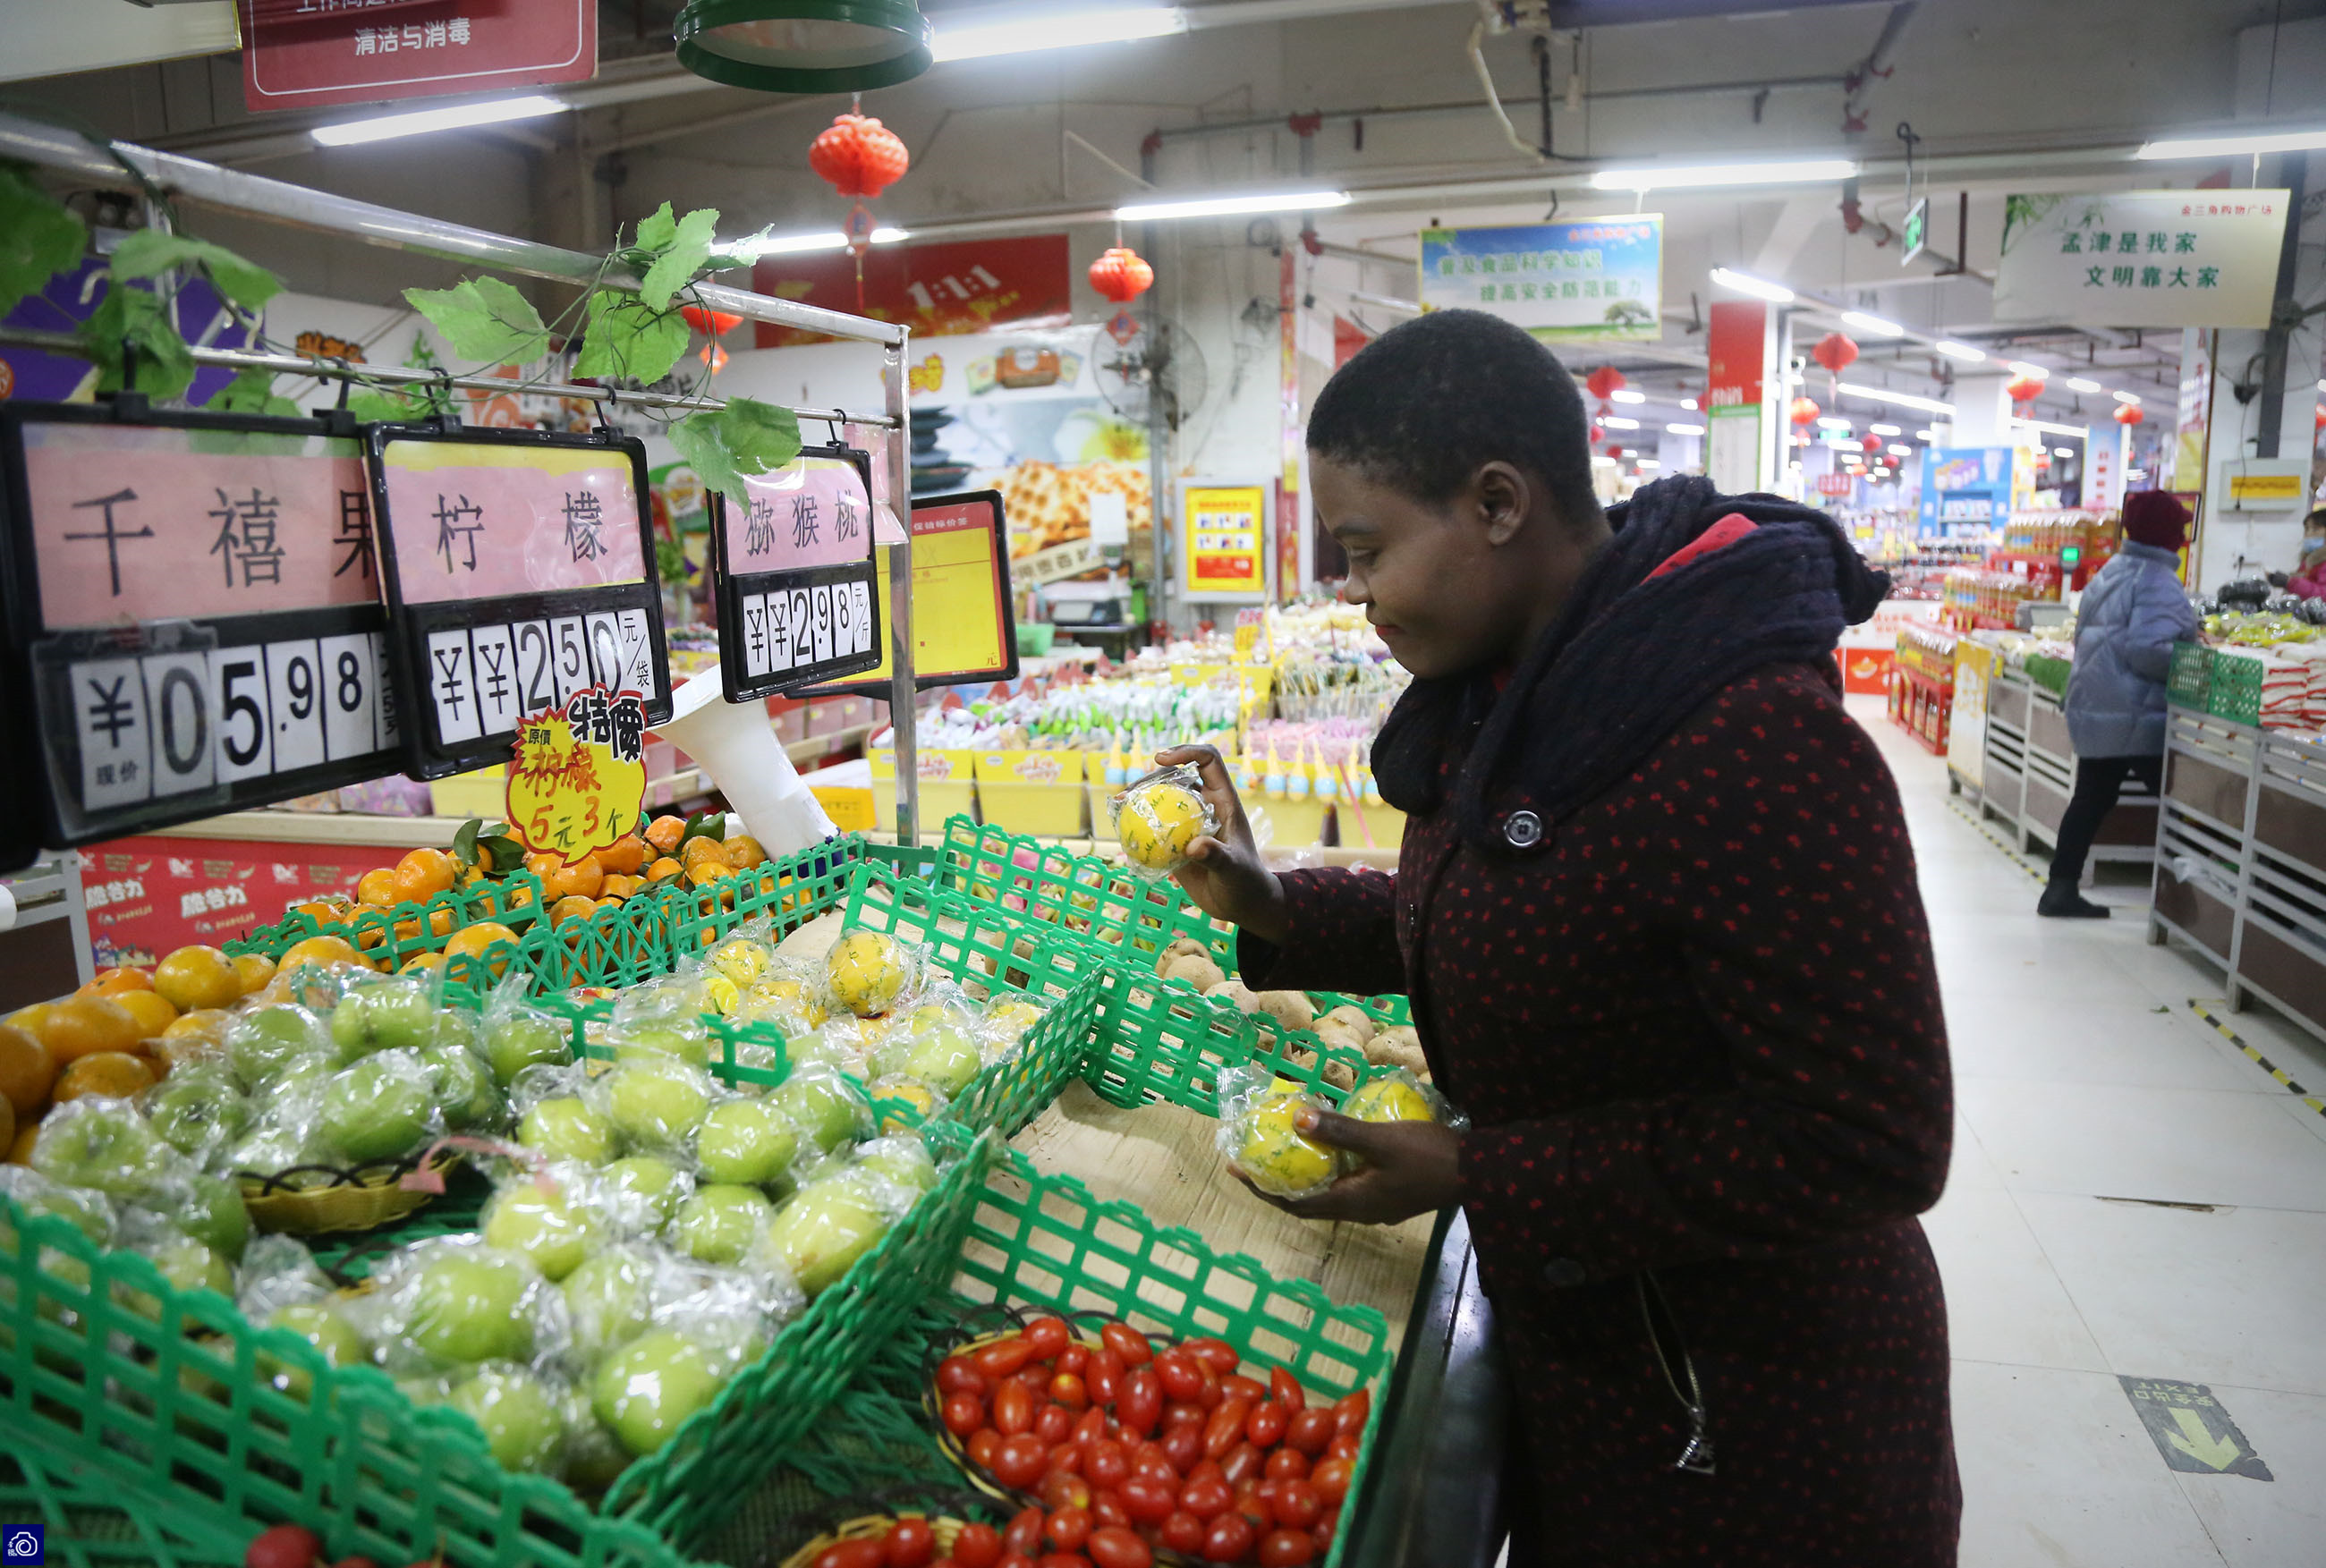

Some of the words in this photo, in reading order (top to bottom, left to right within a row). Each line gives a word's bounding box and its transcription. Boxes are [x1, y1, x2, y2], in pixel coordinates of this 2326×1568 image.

[354, 17, 471, 55] 清洁与消毒
[2181, 204, 2273, 217] 金三角购物广场
[2060, 231, 2198, 254] 孟津是我家
[907, 265, 1001, 308] 1:1:1
[2083, 266, 2220, 288] 文明靠大家
[431, 490, 607, 574] 柠檬
[743, 489, 859, 557] 猕猴桃
[63, 487, 376, 597] 千禧果
[528, 728, 551, 746] 原價
[95, 762, 139, 785] 现价
[530, 795, 624, 849] 5元3个
[2133, 1389, 2214, 1407] 安全出口
